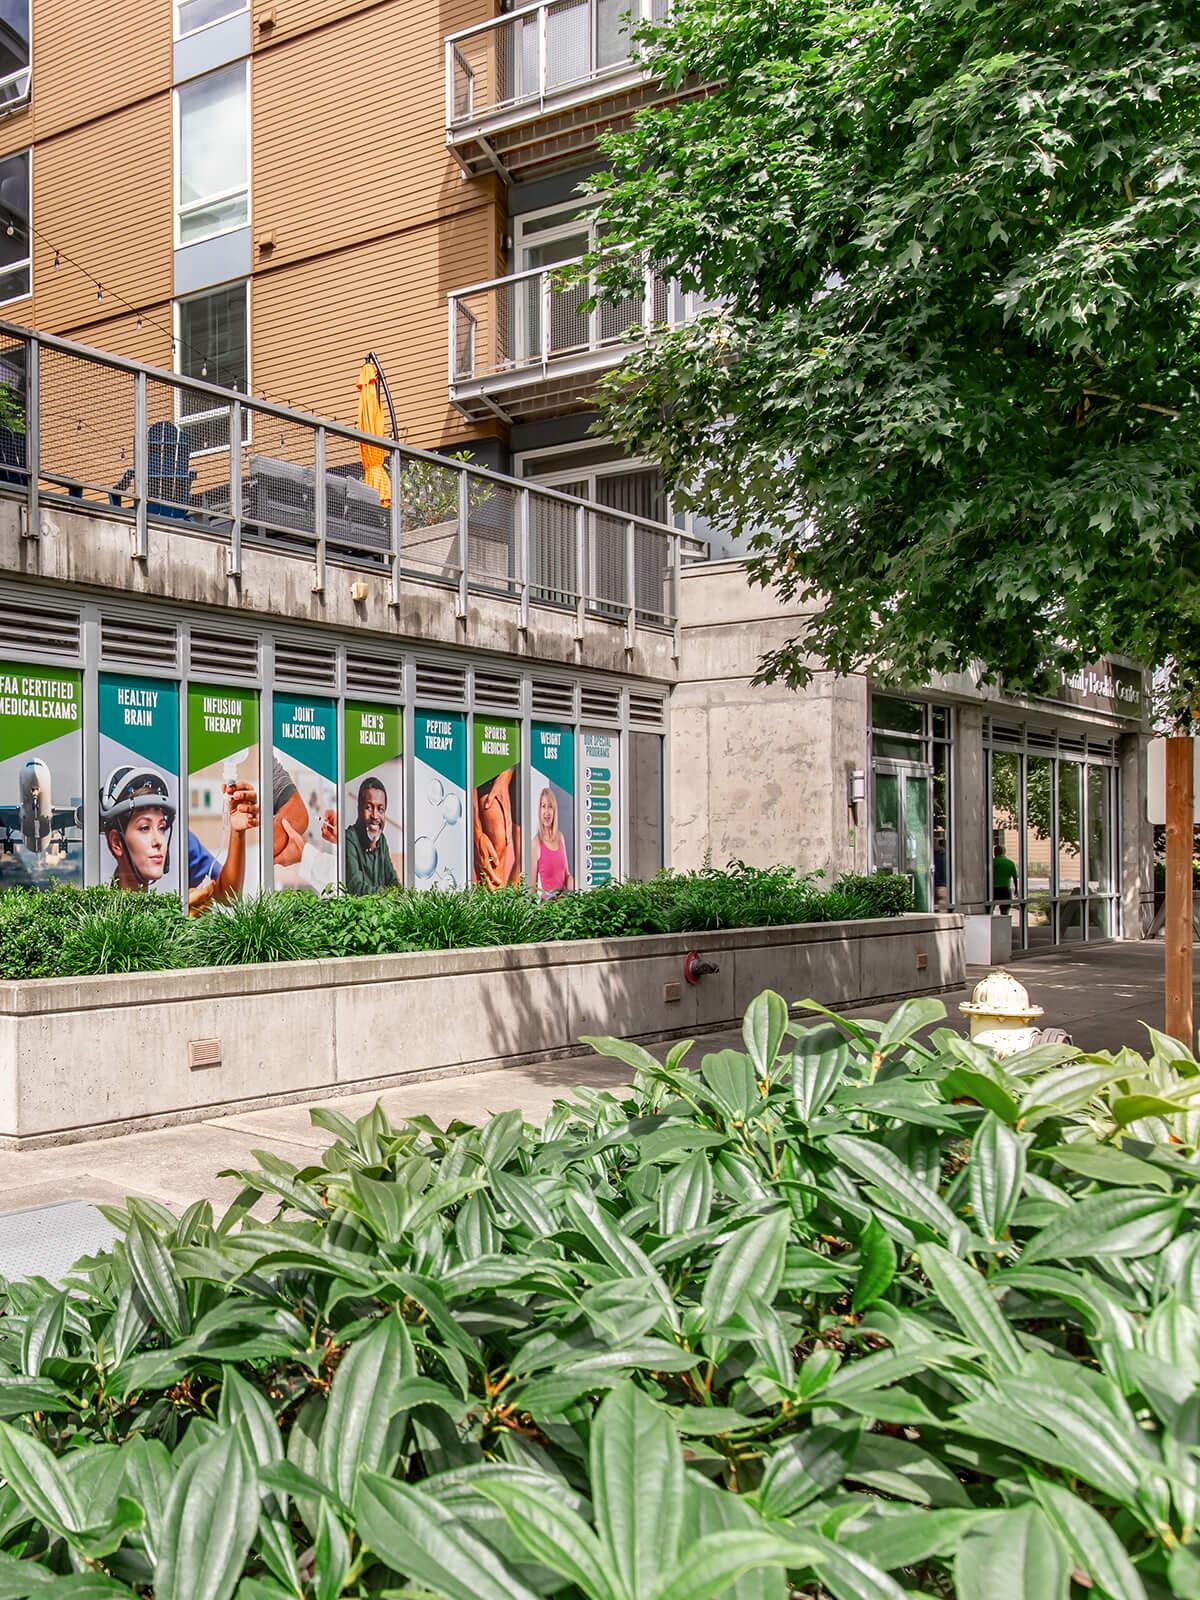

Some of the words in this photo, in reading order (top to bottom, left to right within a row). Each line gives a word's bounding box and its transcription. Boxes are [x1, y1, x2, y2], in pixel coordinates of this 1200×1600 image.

[22, 679, 73, 700] CERTIFIED
[118, 688, 158, 708] HEALTHY
[1115, 680, 1140, 704] Center
[203, 697, 242, 716] INFUSION
[292, 706, 315, 723] JOINT
[124, 708, 152, 726] BRAIN
[204, 715, 241, 734] THERAPY
[361, 713, 384, 729] MEN'S
[282, 722, 325, 741] INJECTIONS
[426, 719, 452, 736] PEPTIDE
[484, 725, 506, 740] SPORTS
[360, 730, 385, 746] HEALTH
[425, 735, 453, 751] THERAPY
[541, 732, 561, 747] WEIGHT
[482, 740, 509, 756] MEDICINE
[544, 746, 557, 760] LOSS
